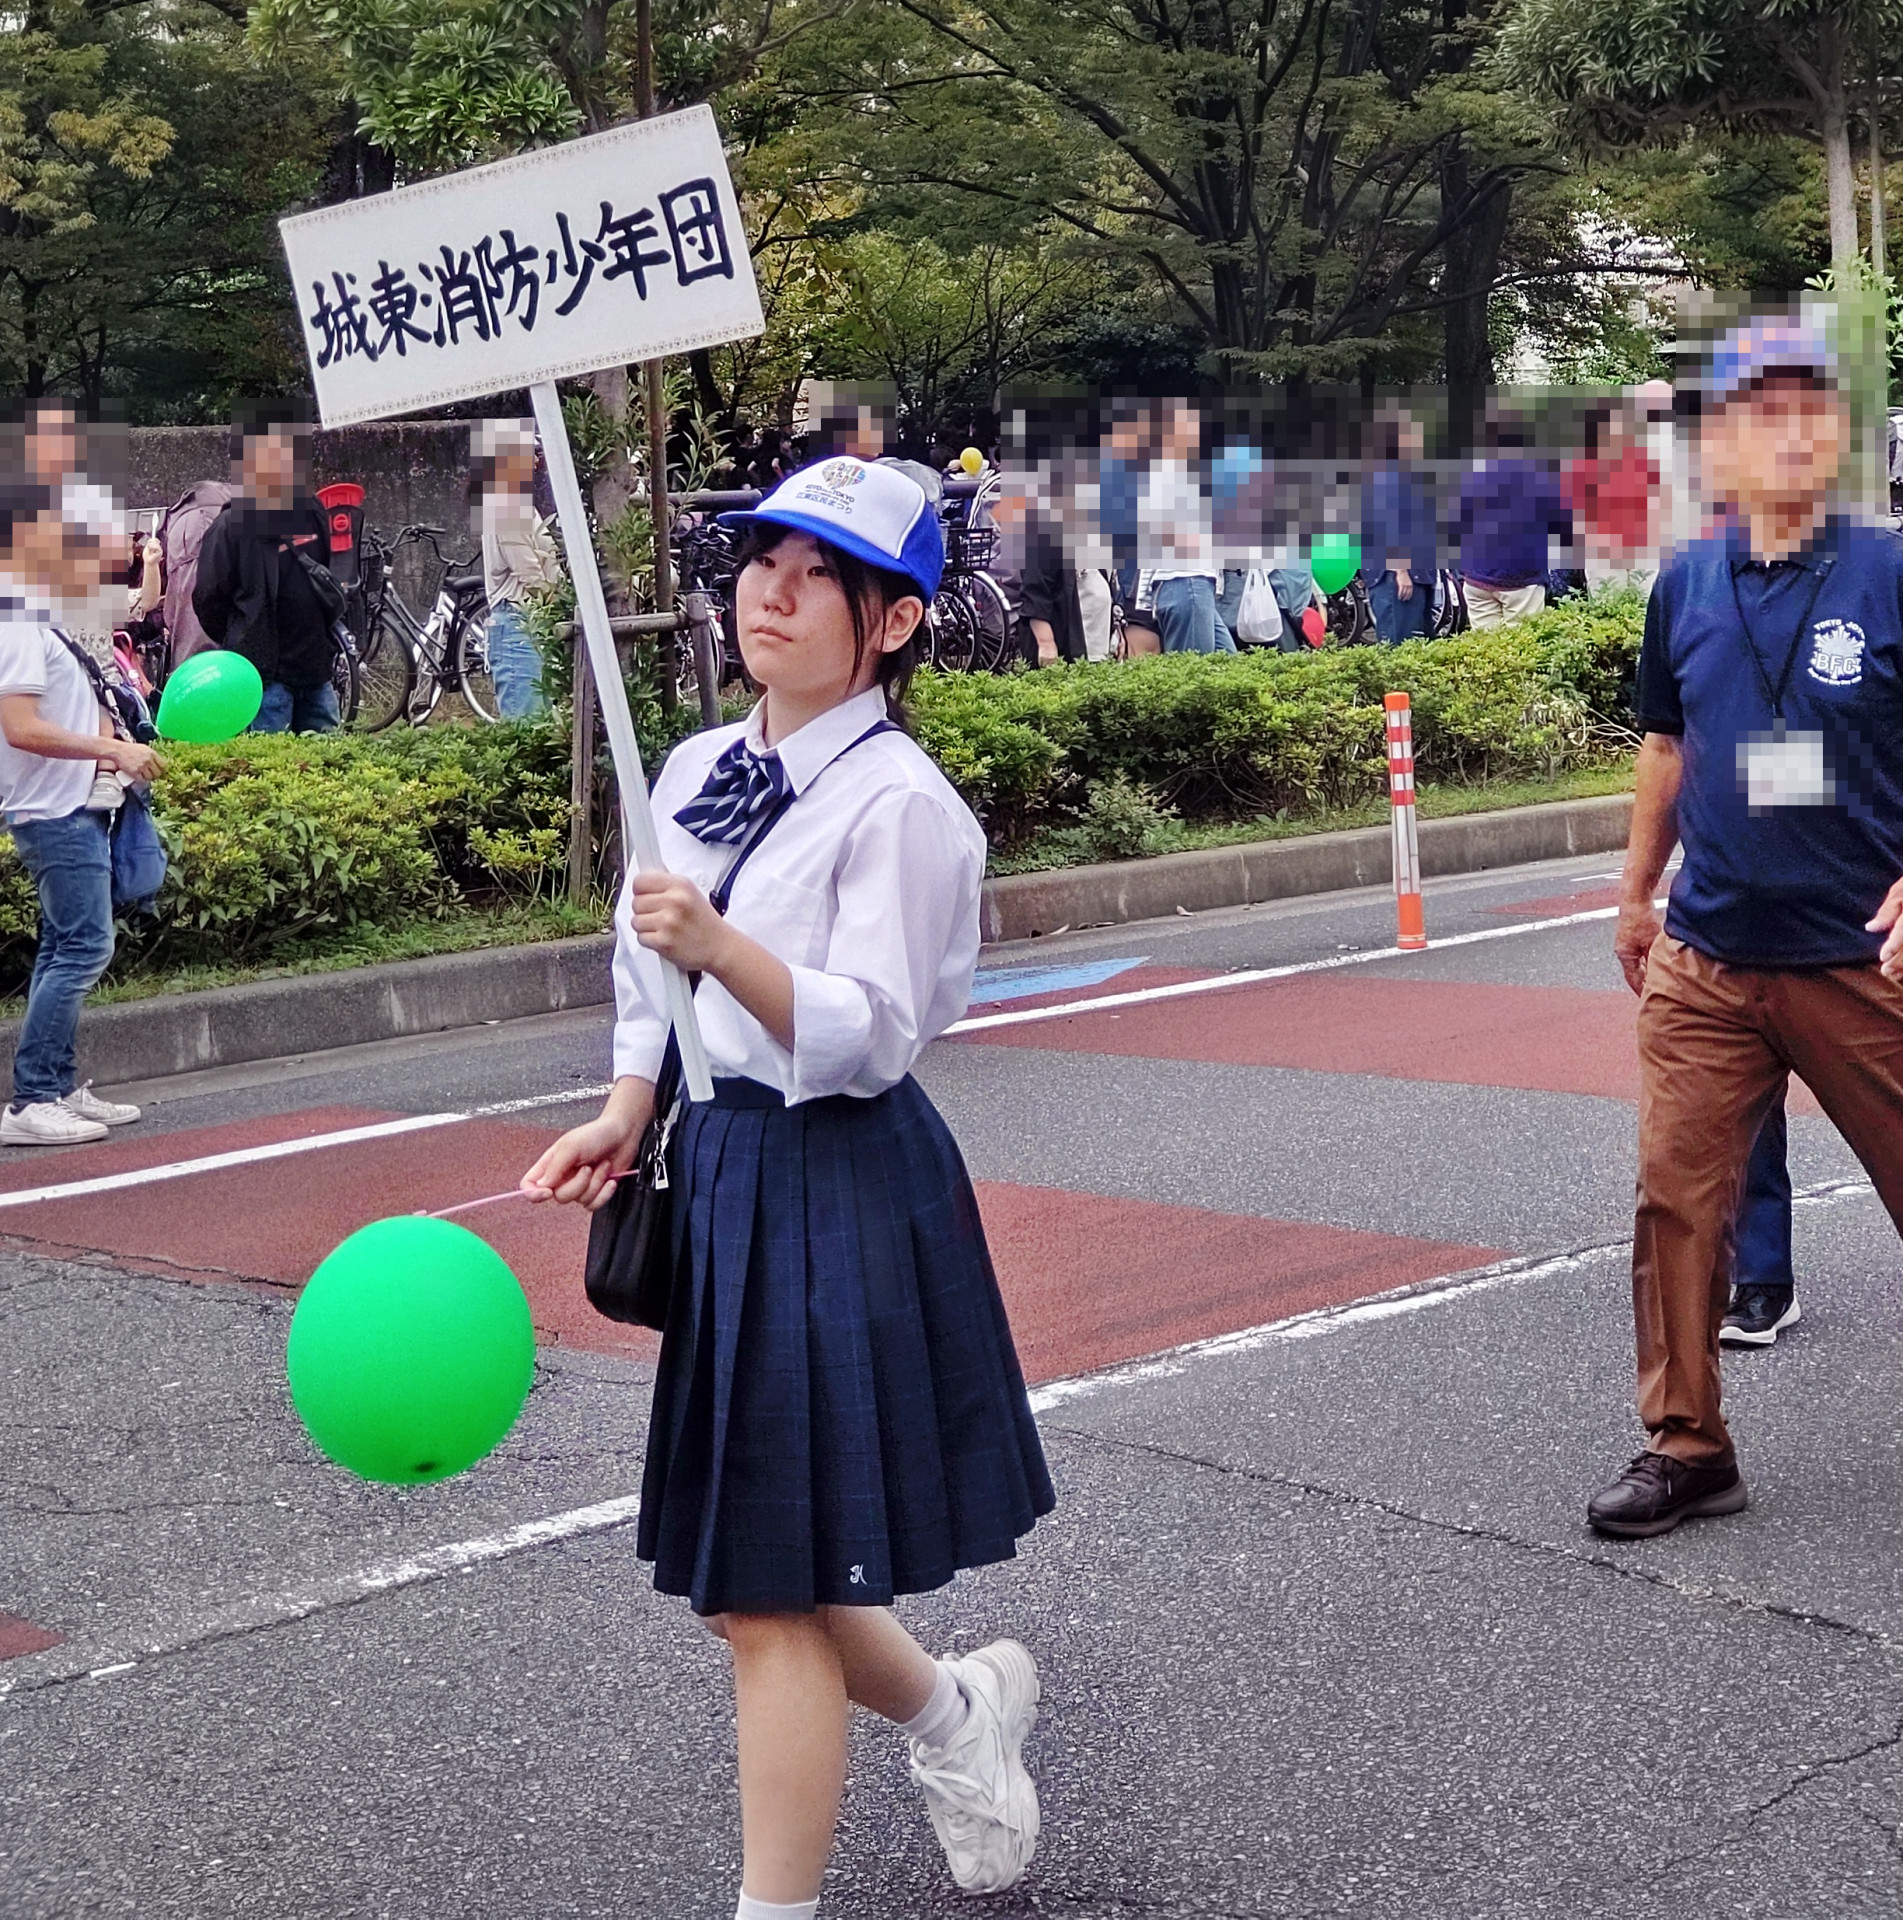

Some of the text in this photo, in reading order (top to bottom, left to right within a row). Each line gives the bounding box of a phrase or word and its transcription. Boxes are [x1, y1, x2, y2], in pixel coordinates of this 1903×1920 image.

[309, 176, 734, 369] 城東消防少年団
[832, 489, 855, 503] TOKYO
[1813, 619, 1842, 631] TOKYO
[1815, 652, 1857, 675] BFC
